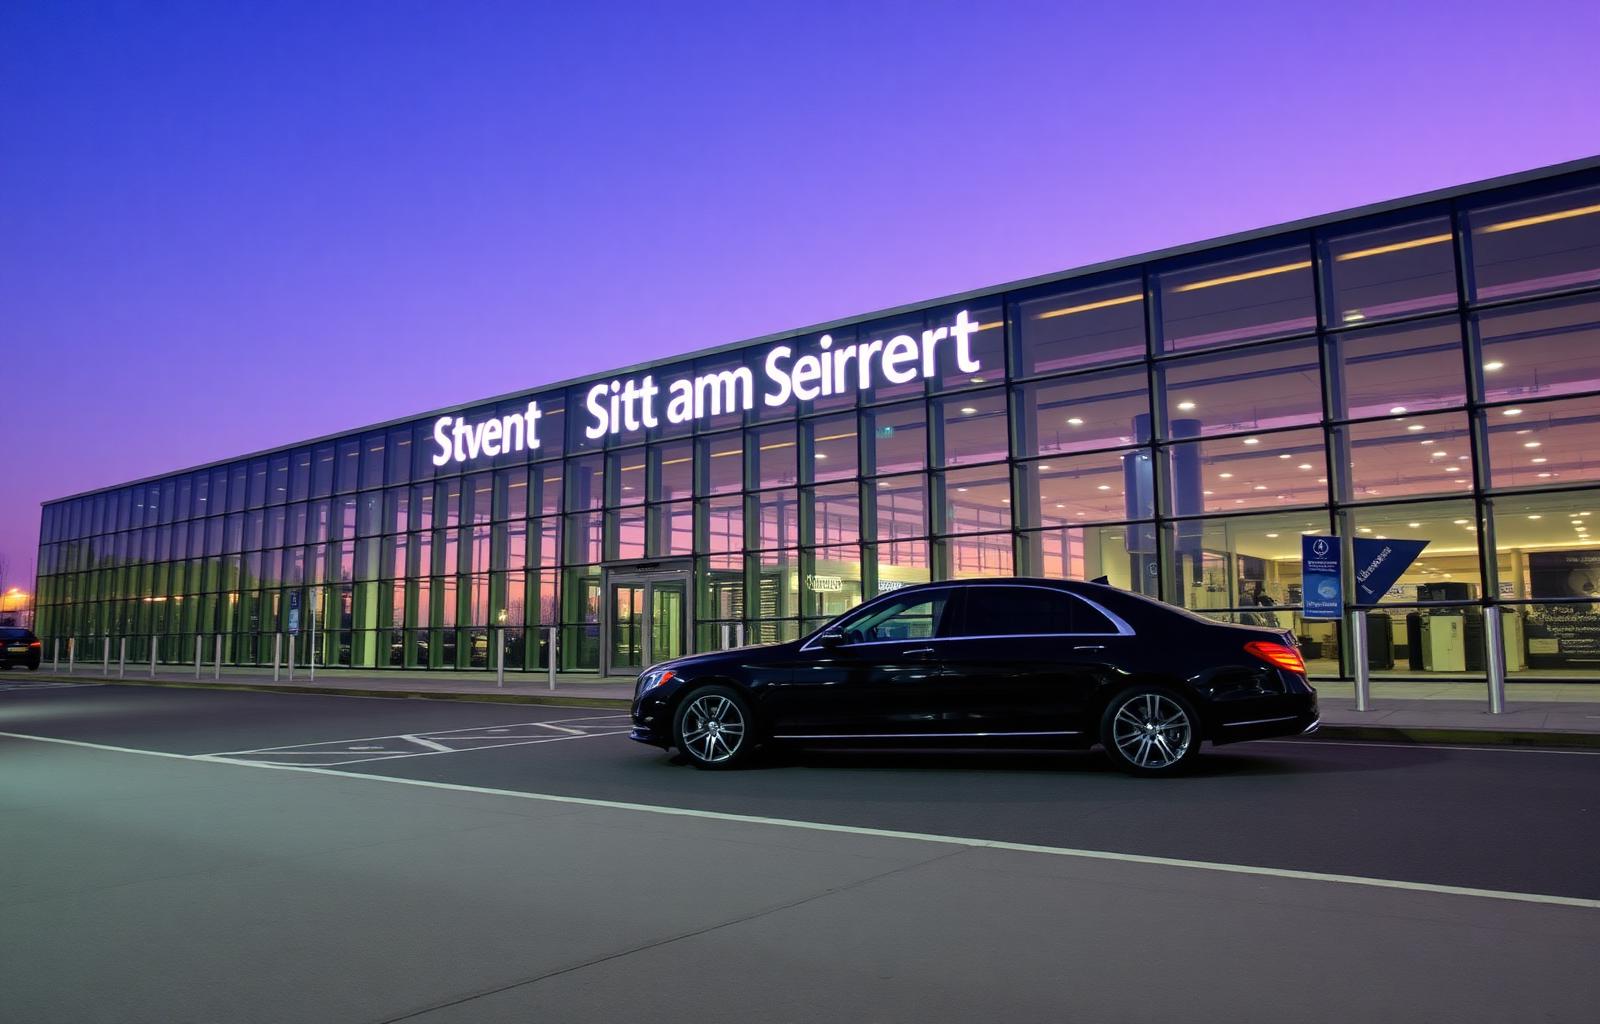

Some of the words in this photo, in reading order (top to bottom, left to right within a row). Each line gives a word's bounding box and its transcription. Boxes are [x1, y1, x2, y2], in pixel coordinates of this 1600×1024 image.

[432, 401, 542, 466] Stvent
[586, 374, 659, 440] Sitt
[764, 309, 981, 407] Seirrert
